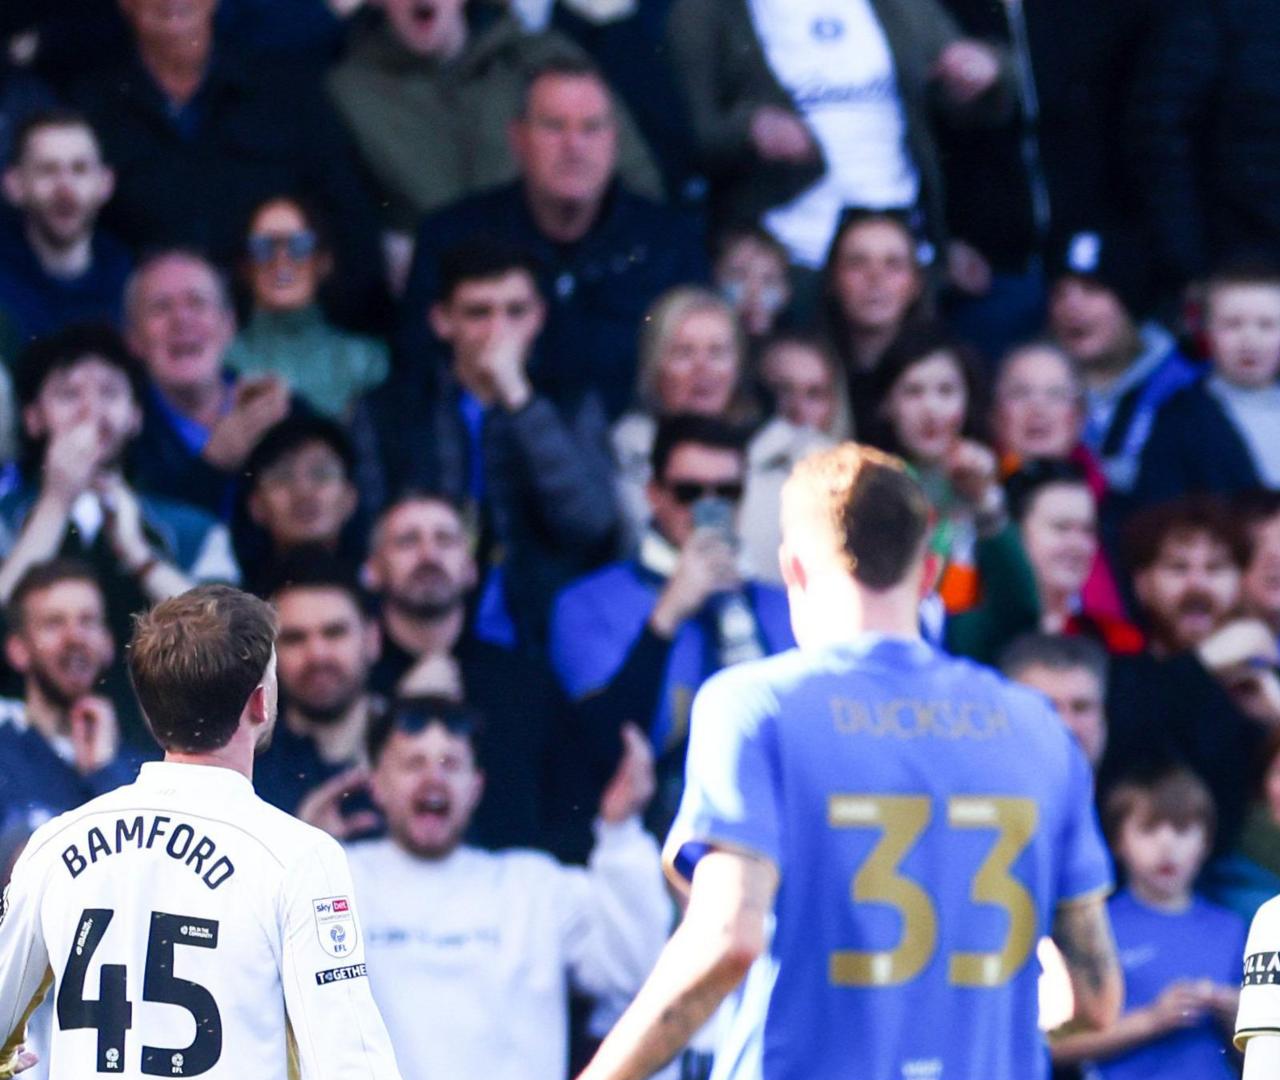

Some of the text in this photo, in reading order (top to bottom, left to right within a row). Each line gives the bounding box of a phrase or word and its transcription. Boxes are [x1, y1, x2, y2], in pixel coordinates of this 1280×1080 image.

[62, 816, 234, 890] BAMFORD
[317, 903, 331, 912] sky
[828, 794, 1038, 988] 33
[57, 909, 222, 1077] 45
[318, 965, 367, 984] TOGETHE
